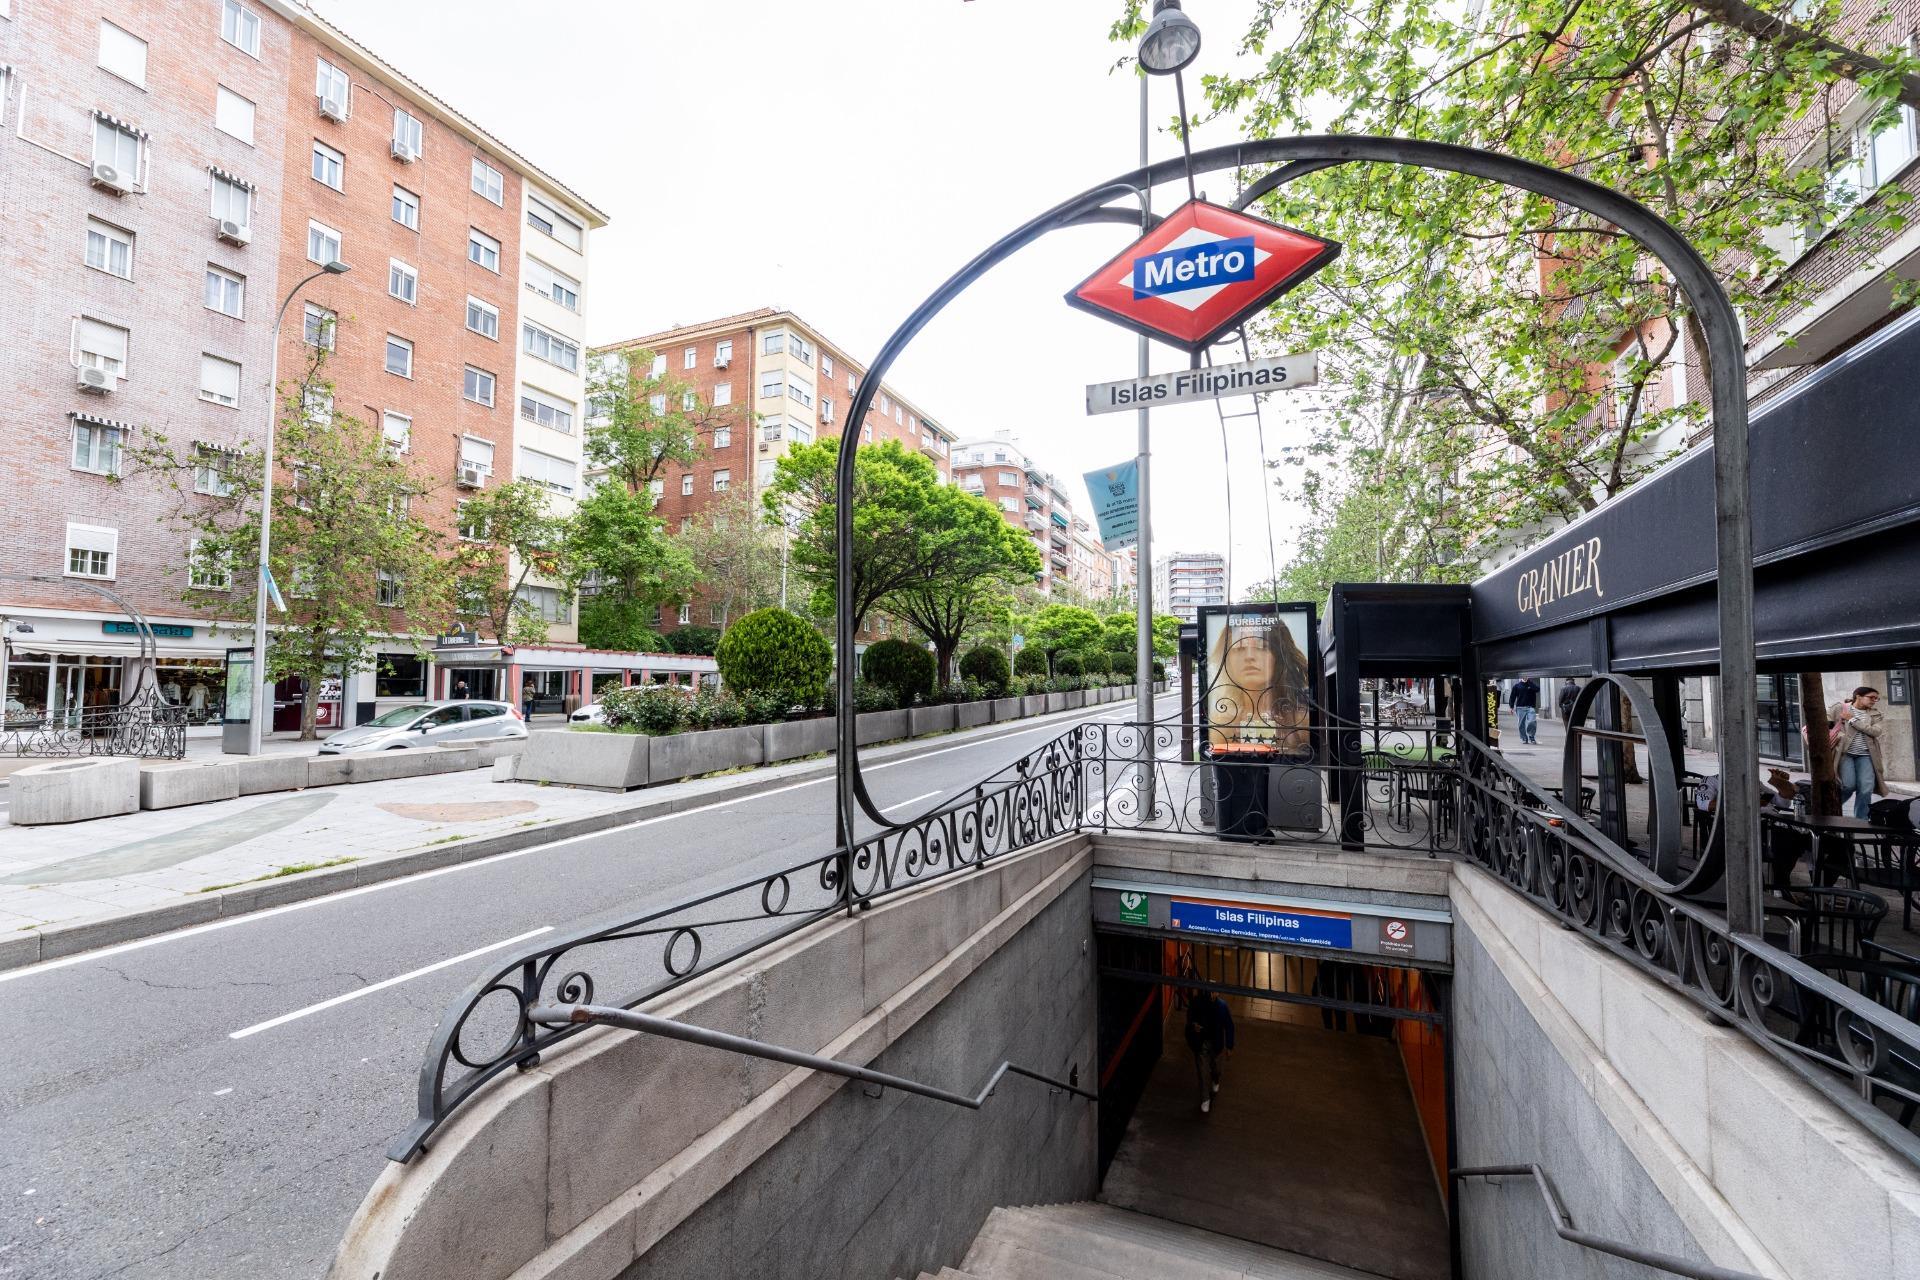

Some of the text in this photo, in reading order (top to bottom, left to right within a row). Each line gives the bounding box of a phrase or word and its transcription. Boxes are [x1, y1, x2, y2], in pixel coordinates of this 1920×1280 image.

[1144, 251, 1245, 288] Metro
[1111, 365, 1287, 406] Islas Filipinas
[1517, 536, 1604, 618] GRANIER
[1215, 909, 1300, 929] Islas Filipinas
